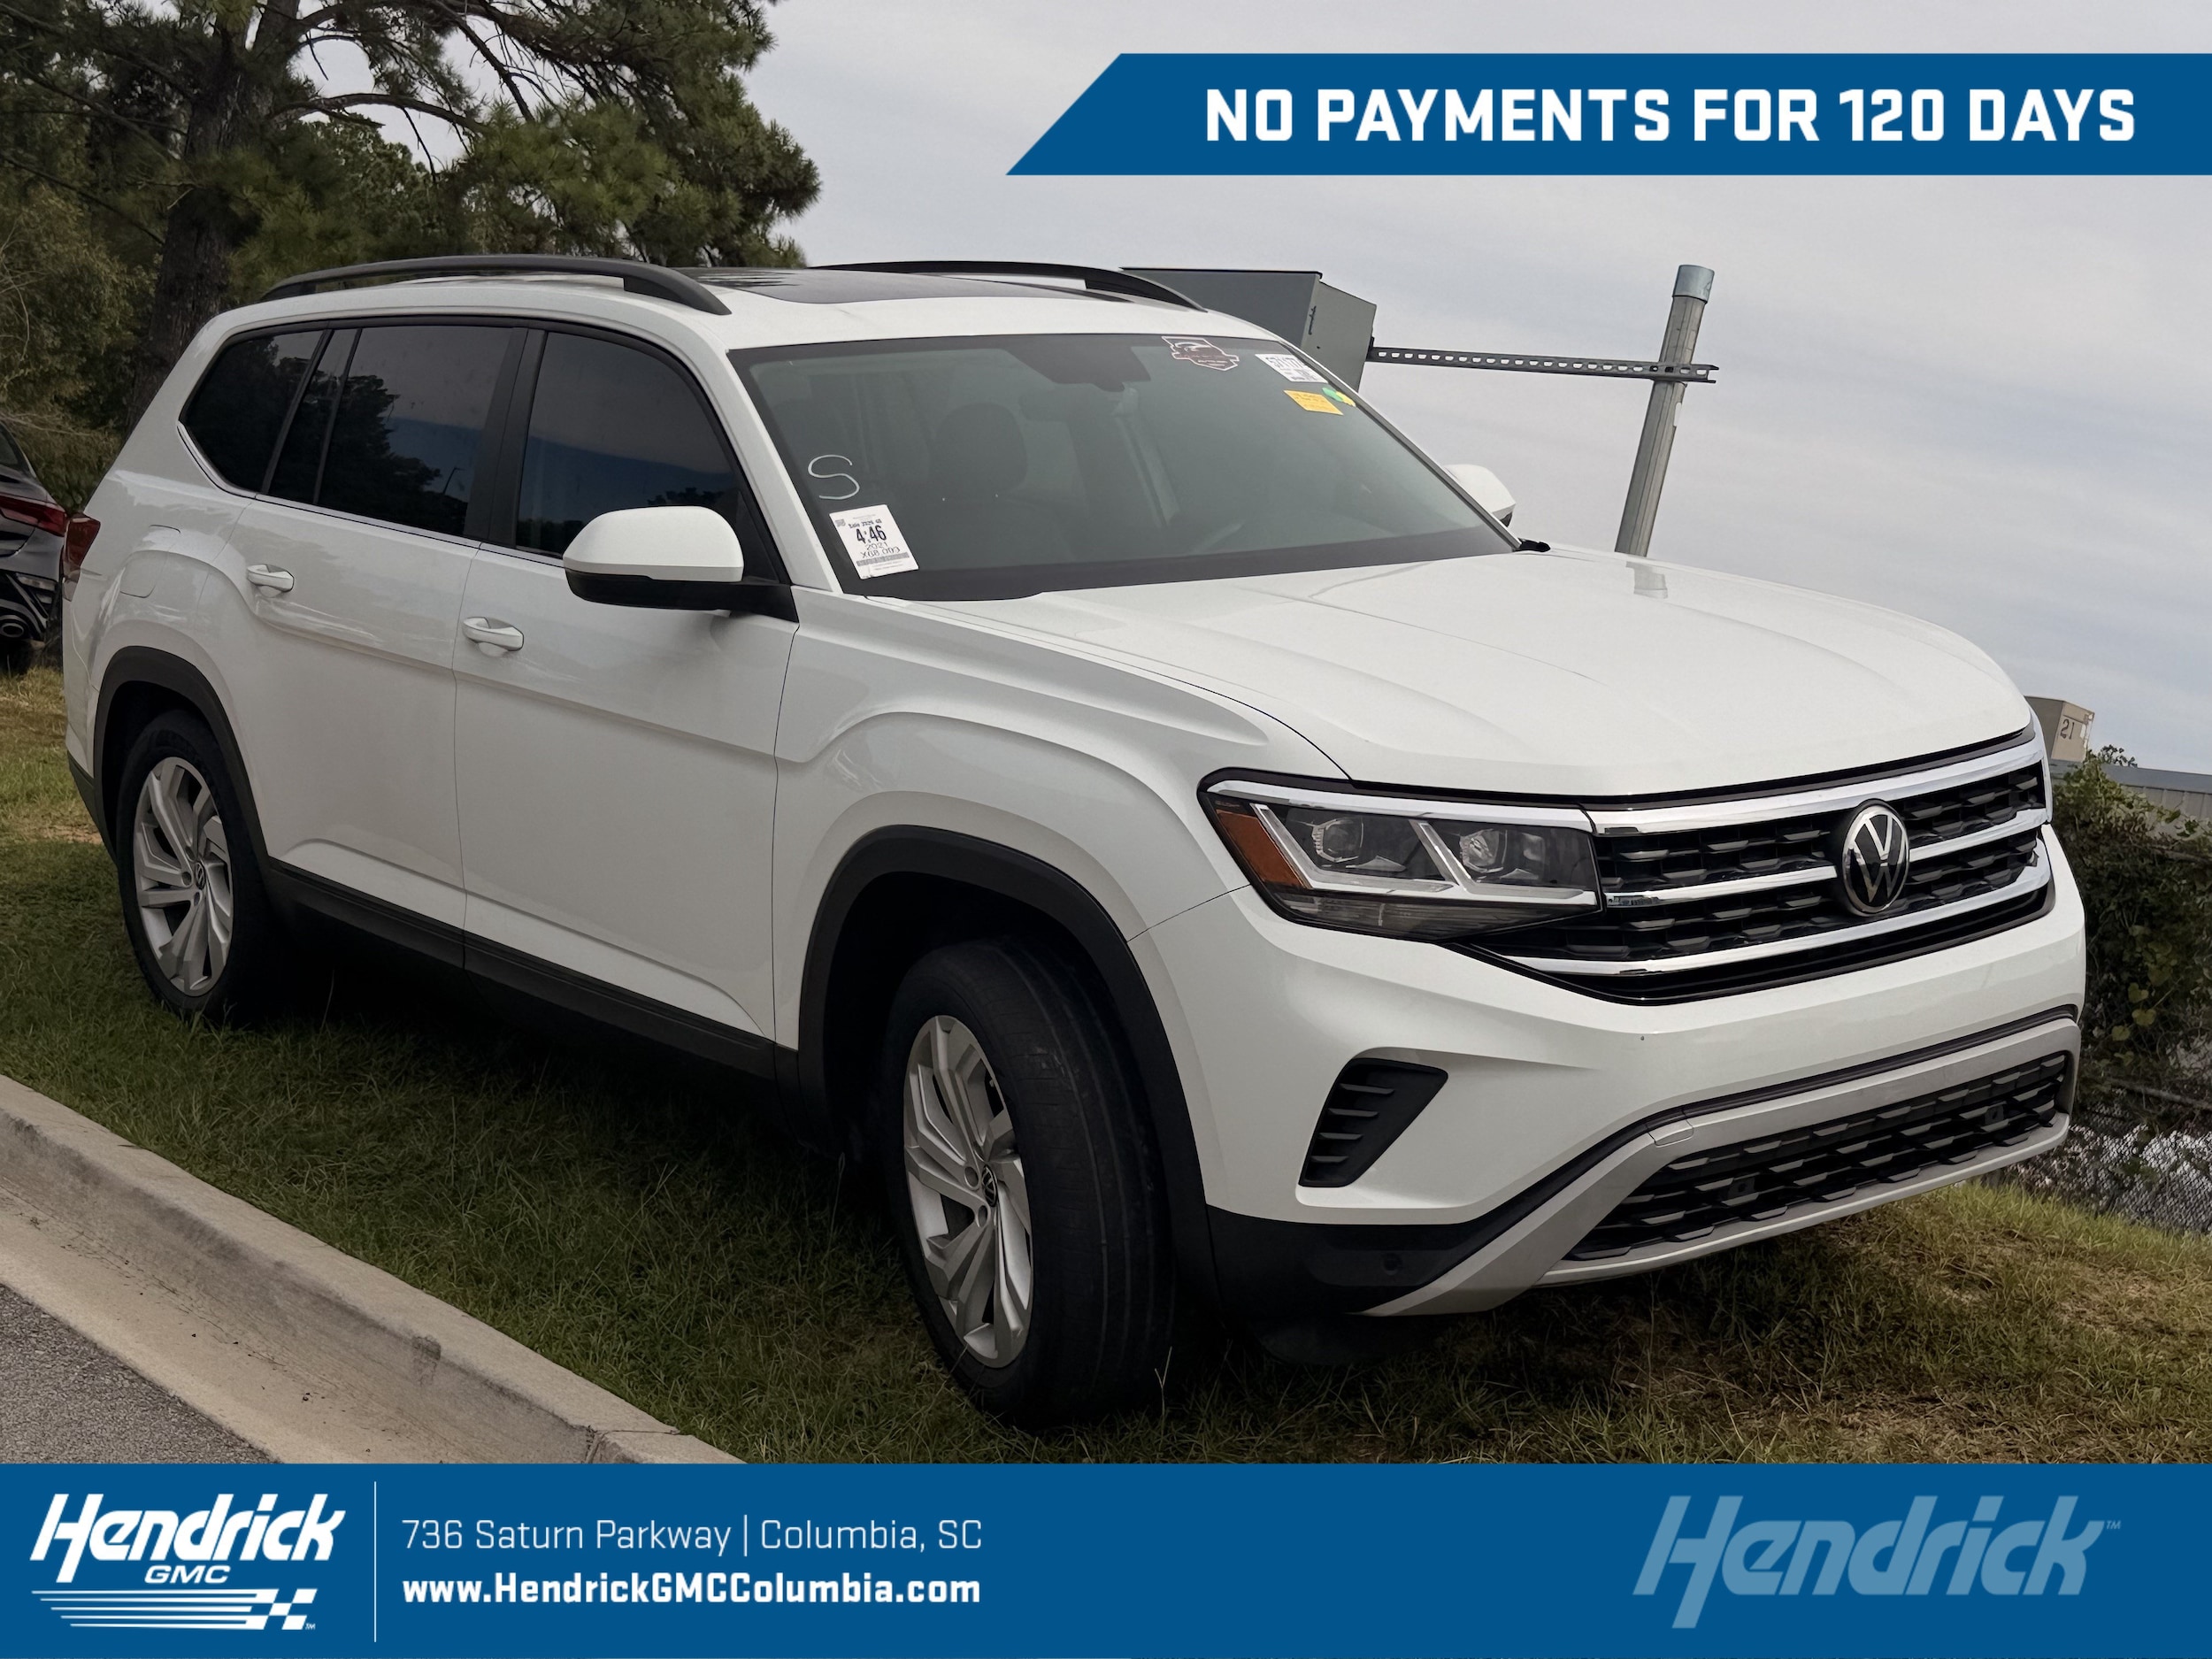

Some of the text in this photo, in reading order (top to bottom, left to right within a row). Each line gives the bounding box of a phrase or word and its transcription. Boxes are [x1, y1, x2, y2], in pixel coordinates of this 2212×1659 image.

[807, 454, 860, 500] S
[856, 525, 887, 544] 4:46
[2060, 718, 2075, 740] 21
